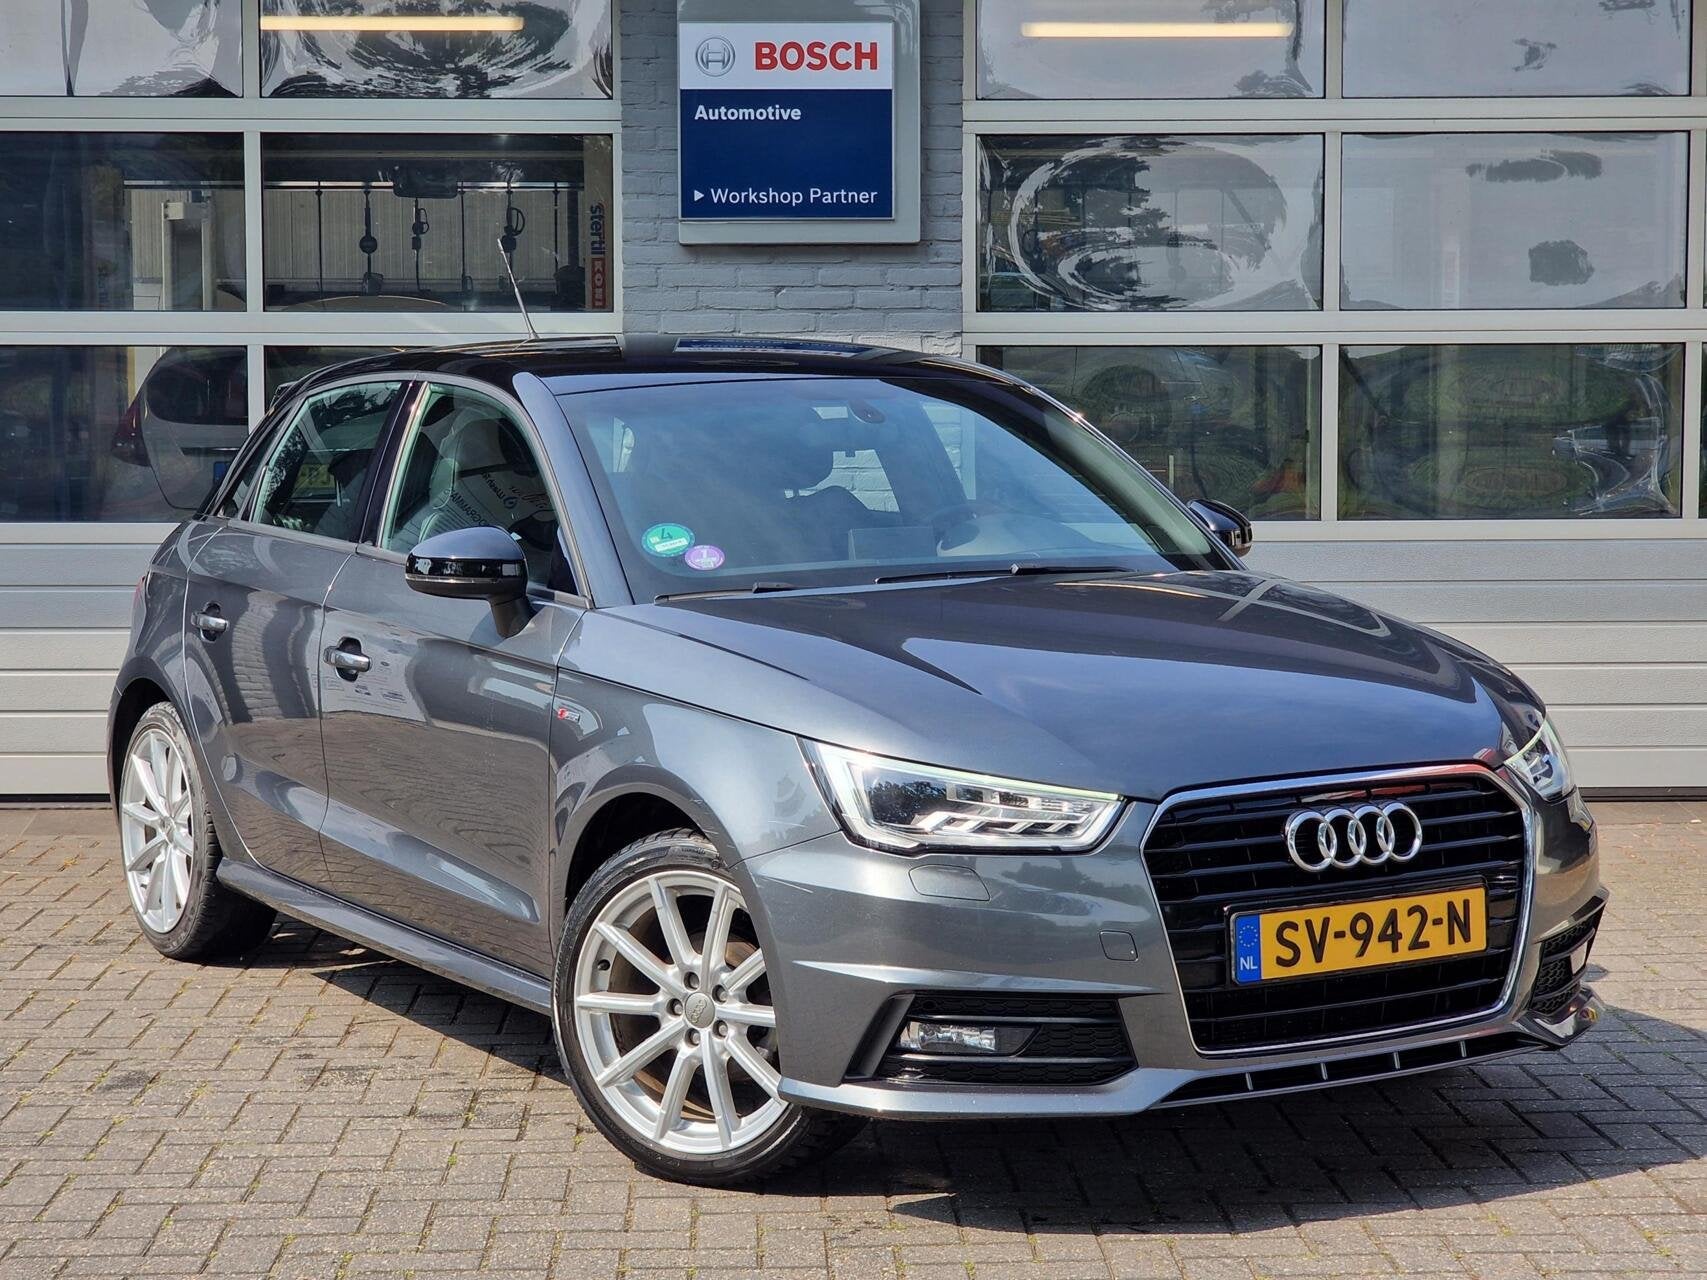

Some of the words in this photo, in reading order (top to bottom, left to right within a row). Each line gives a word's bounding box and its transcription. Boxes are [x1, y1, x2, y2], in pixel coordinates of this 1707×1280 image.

[754, 41, 878, 71] BOSCH
[694, 104, 802, 121] Automotive
[710, 187, 803, 206] Workshop
[809, 187, 878, 204] Partner
[590, 203, 606, 255] stertil
[1275, 898, 1471, 968] SV-942-N
[1239, 956, 1258, 972] NL
